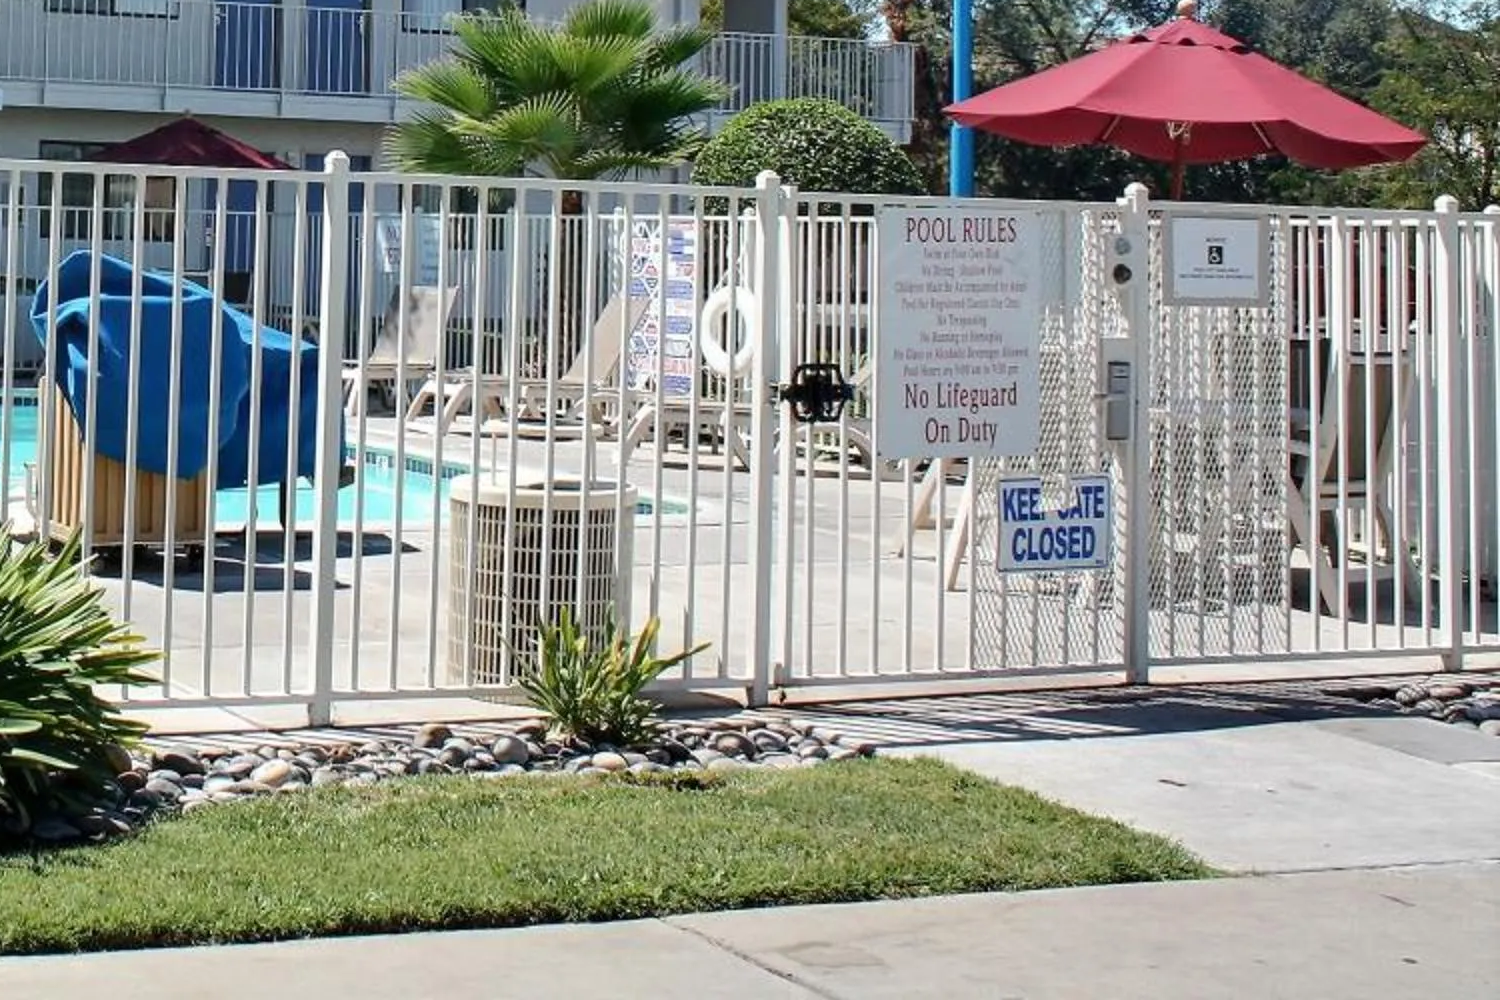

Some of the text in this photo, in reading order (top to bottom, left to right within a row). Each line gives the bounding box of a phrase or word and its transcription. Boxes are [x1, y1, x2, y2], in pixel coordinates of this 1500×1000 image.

[906, 217, 1017, 243] POOL RULES
[905, 381, 1017, 414] No Lifeguard
[925, 417, 998, 449] On Duty
[1003, 485, 1105, 522] KEE ATE
[1012, 525, 1096, 562] CLOSED
